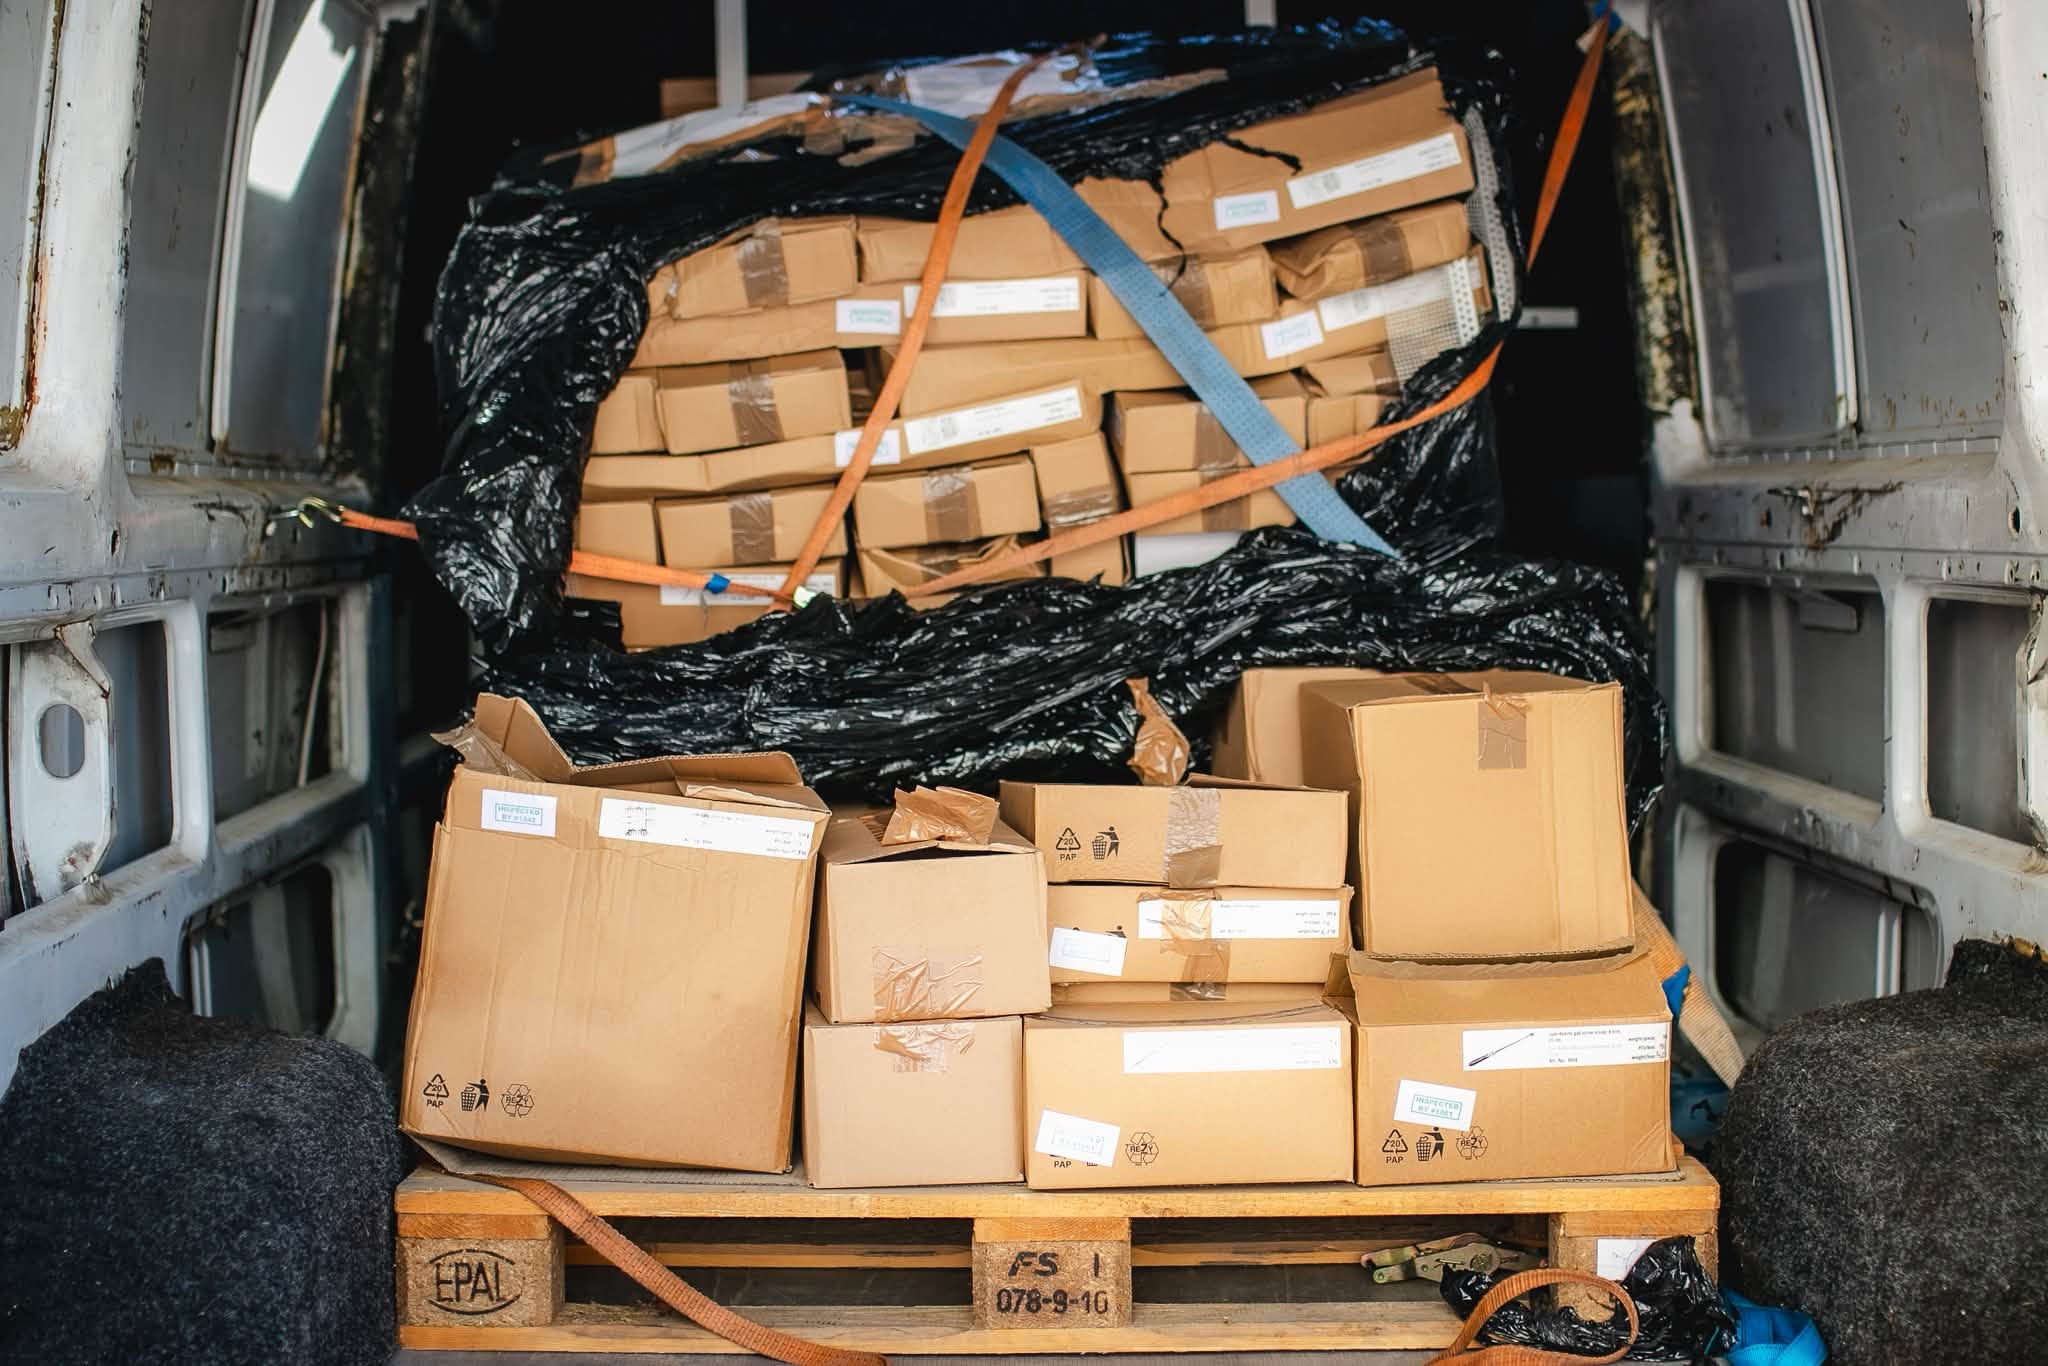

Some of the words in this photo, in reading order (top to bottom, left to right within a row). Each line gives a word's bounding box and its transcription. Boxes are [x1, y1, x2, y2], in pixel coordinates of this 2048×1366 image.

[1064, 838, 1074, 846] 20
[431, 1084, 442, 1092] 20
[426, 1099, 444, 1108] PAP
[1391, 1140, 1401, 1148] 20
[1386, 1156, 1404, 1164] PAP
[434, 1261, 507, 1302] EPAL
[996, 1288, 1108, 1314] 078-9-10
